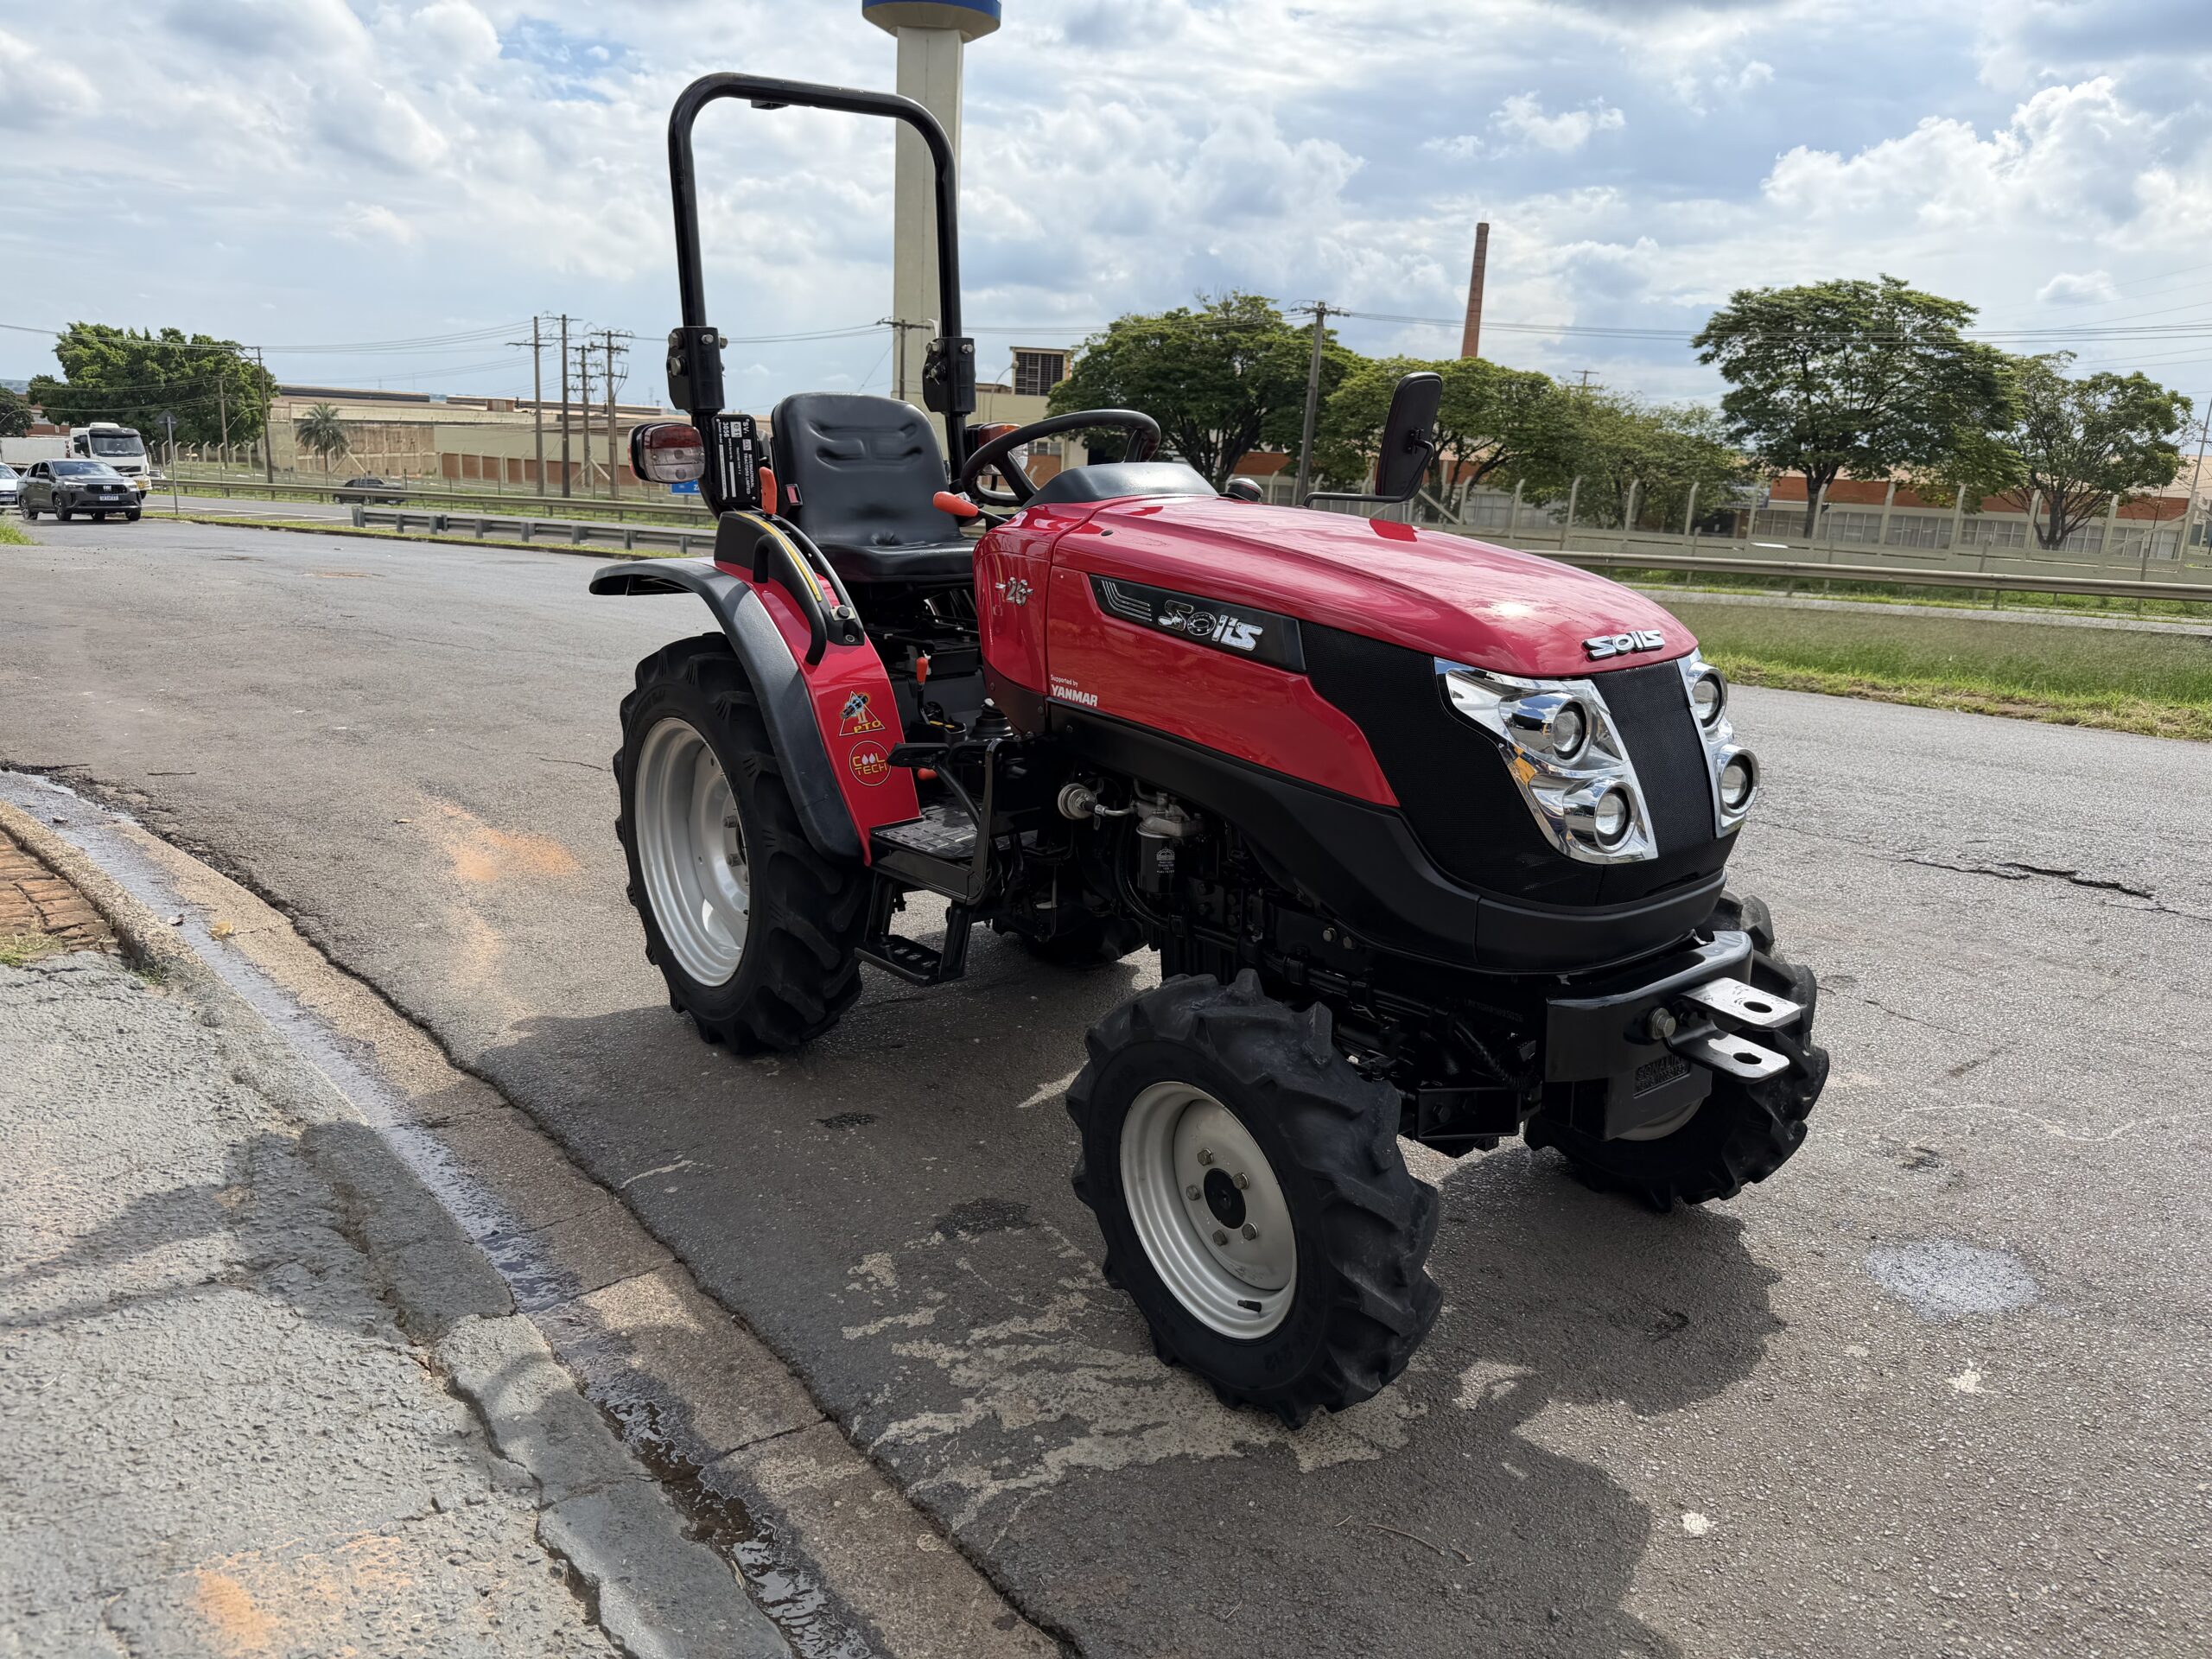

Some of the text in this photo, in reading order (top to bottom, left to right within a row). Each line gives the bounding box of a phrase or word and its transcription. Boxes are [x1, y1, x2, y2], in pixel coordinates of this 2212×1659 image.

[1051, 674, 1078, 688] Supported by
[1051, 683, 1098, 707] YANMAR
[853, 720, 881, 734] PTO
[855, 762, 887, 776] TECH
